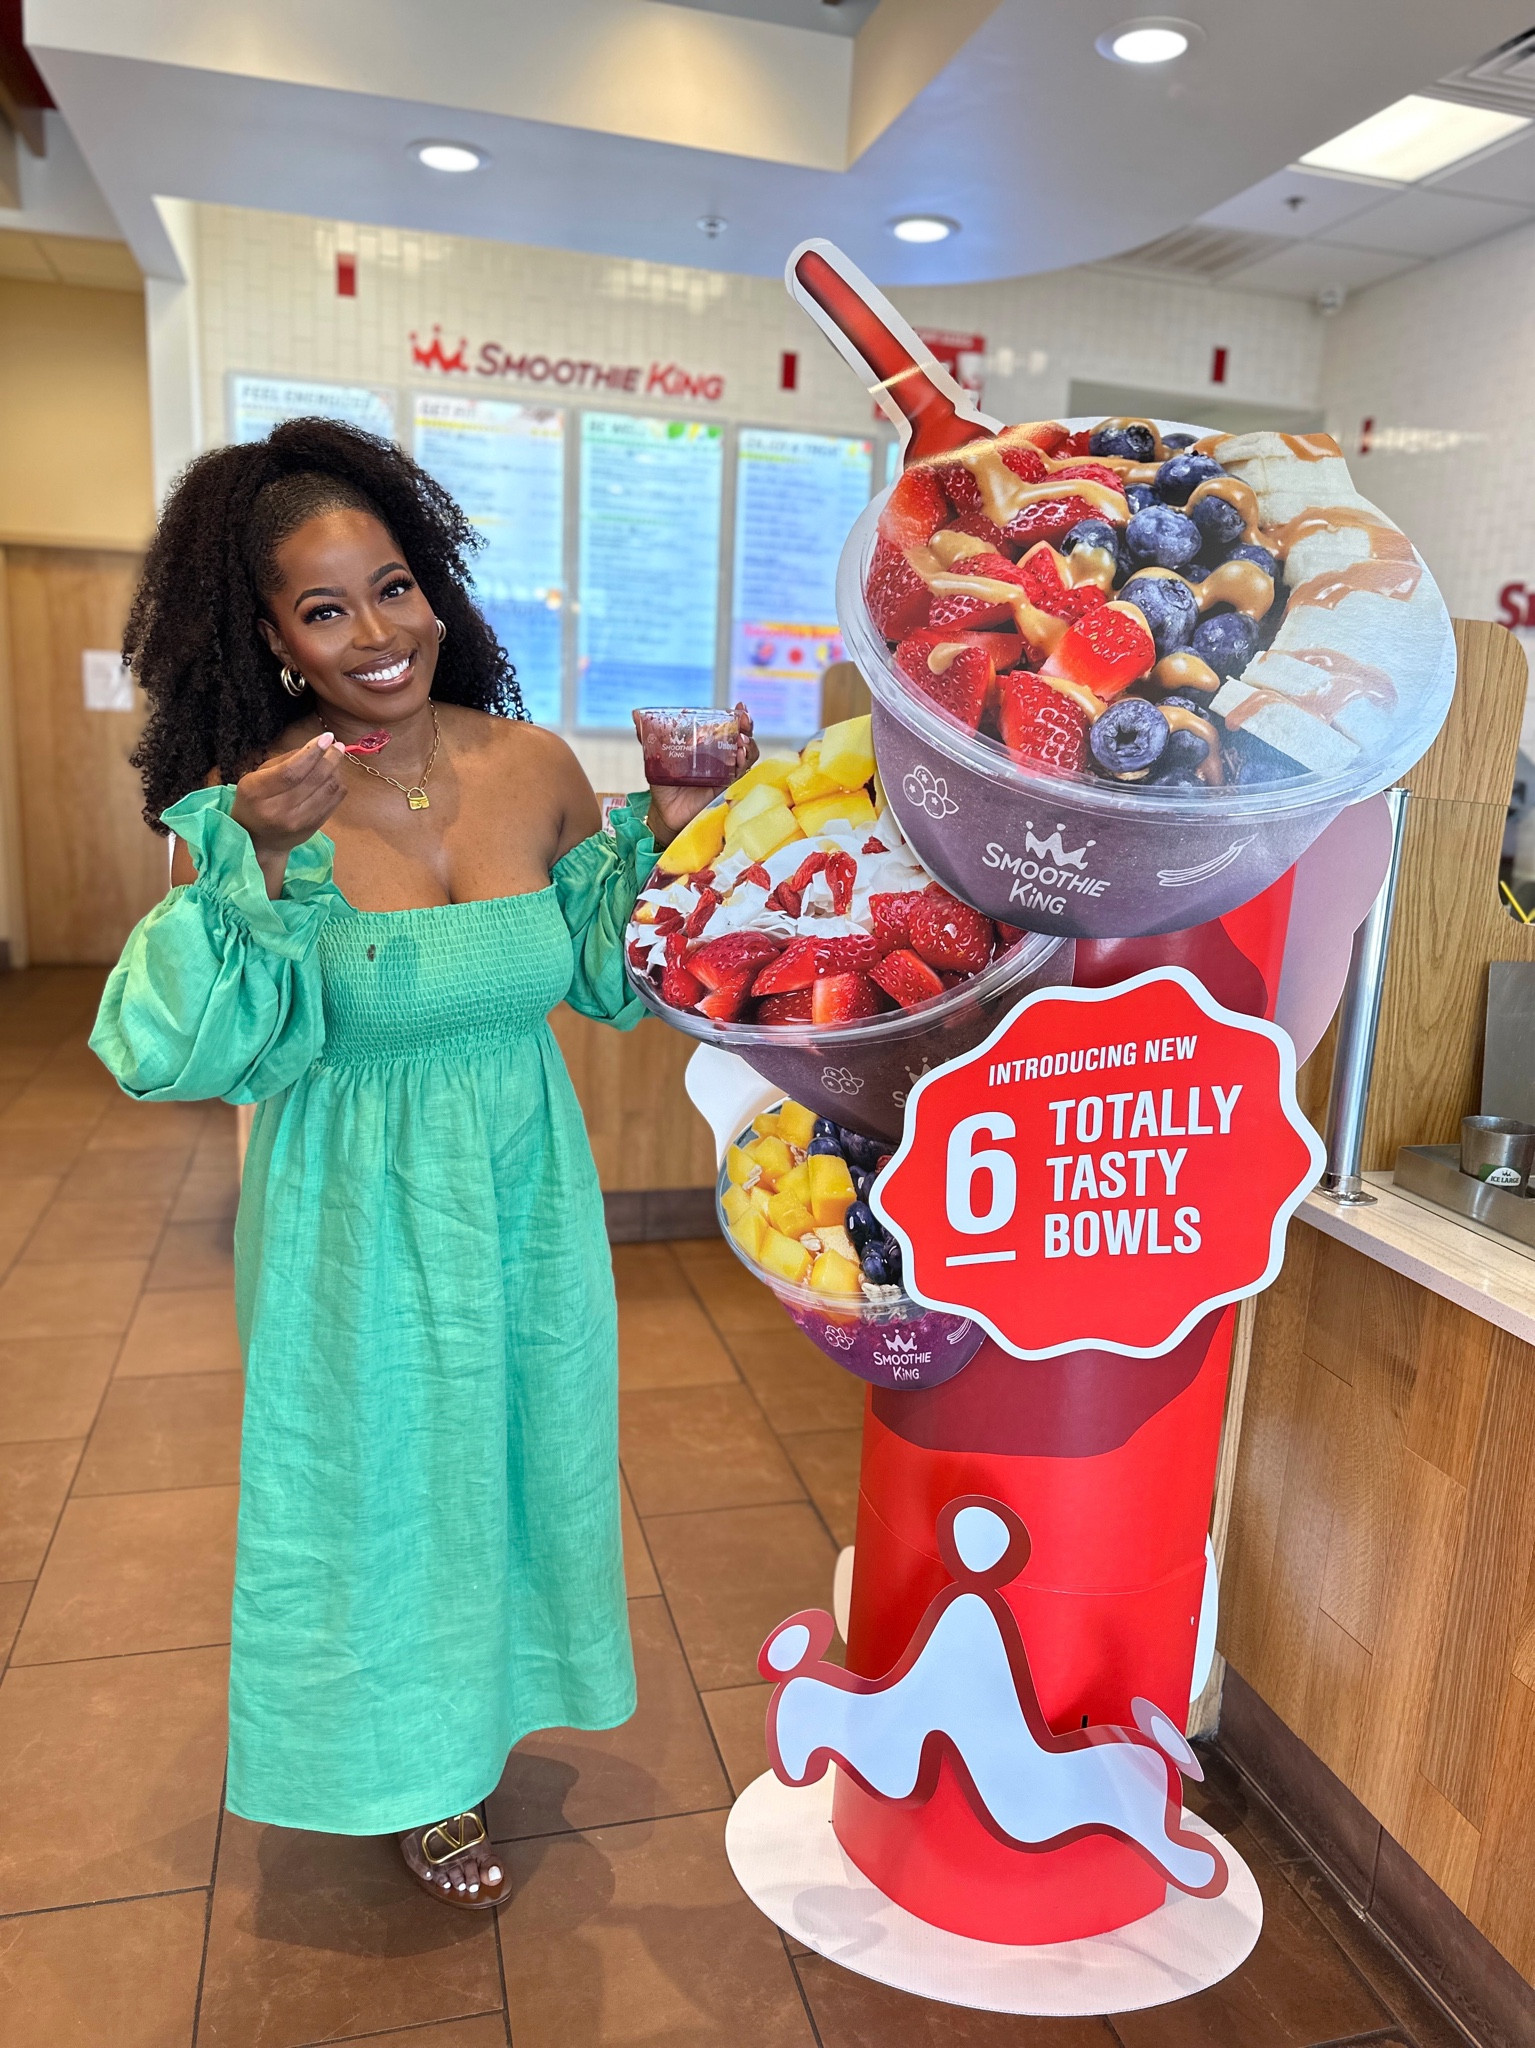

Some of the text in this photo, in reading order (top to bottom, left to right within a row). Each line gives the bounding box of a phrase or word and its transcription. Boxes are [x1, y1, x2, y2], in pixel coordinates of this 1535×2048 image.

[476, 342, 643, 393] SMOOTHIE
[982, 842, 1111, 897] SMOOTHIE
[988, 1035, 1198, 1087] INTRODUCING NEW
[1048, 1084, 1244, 1146] TOTALLY
[945, 1111, 1017, 1235] 6
[1046, 1147, 1188, 1202] TASTY
[1490, 1175, 1500, 1183] ICE
[1044, 1206, 1202, 1259] BOWLS
[873, 1351, 932, 1366] SMOOTHIE
